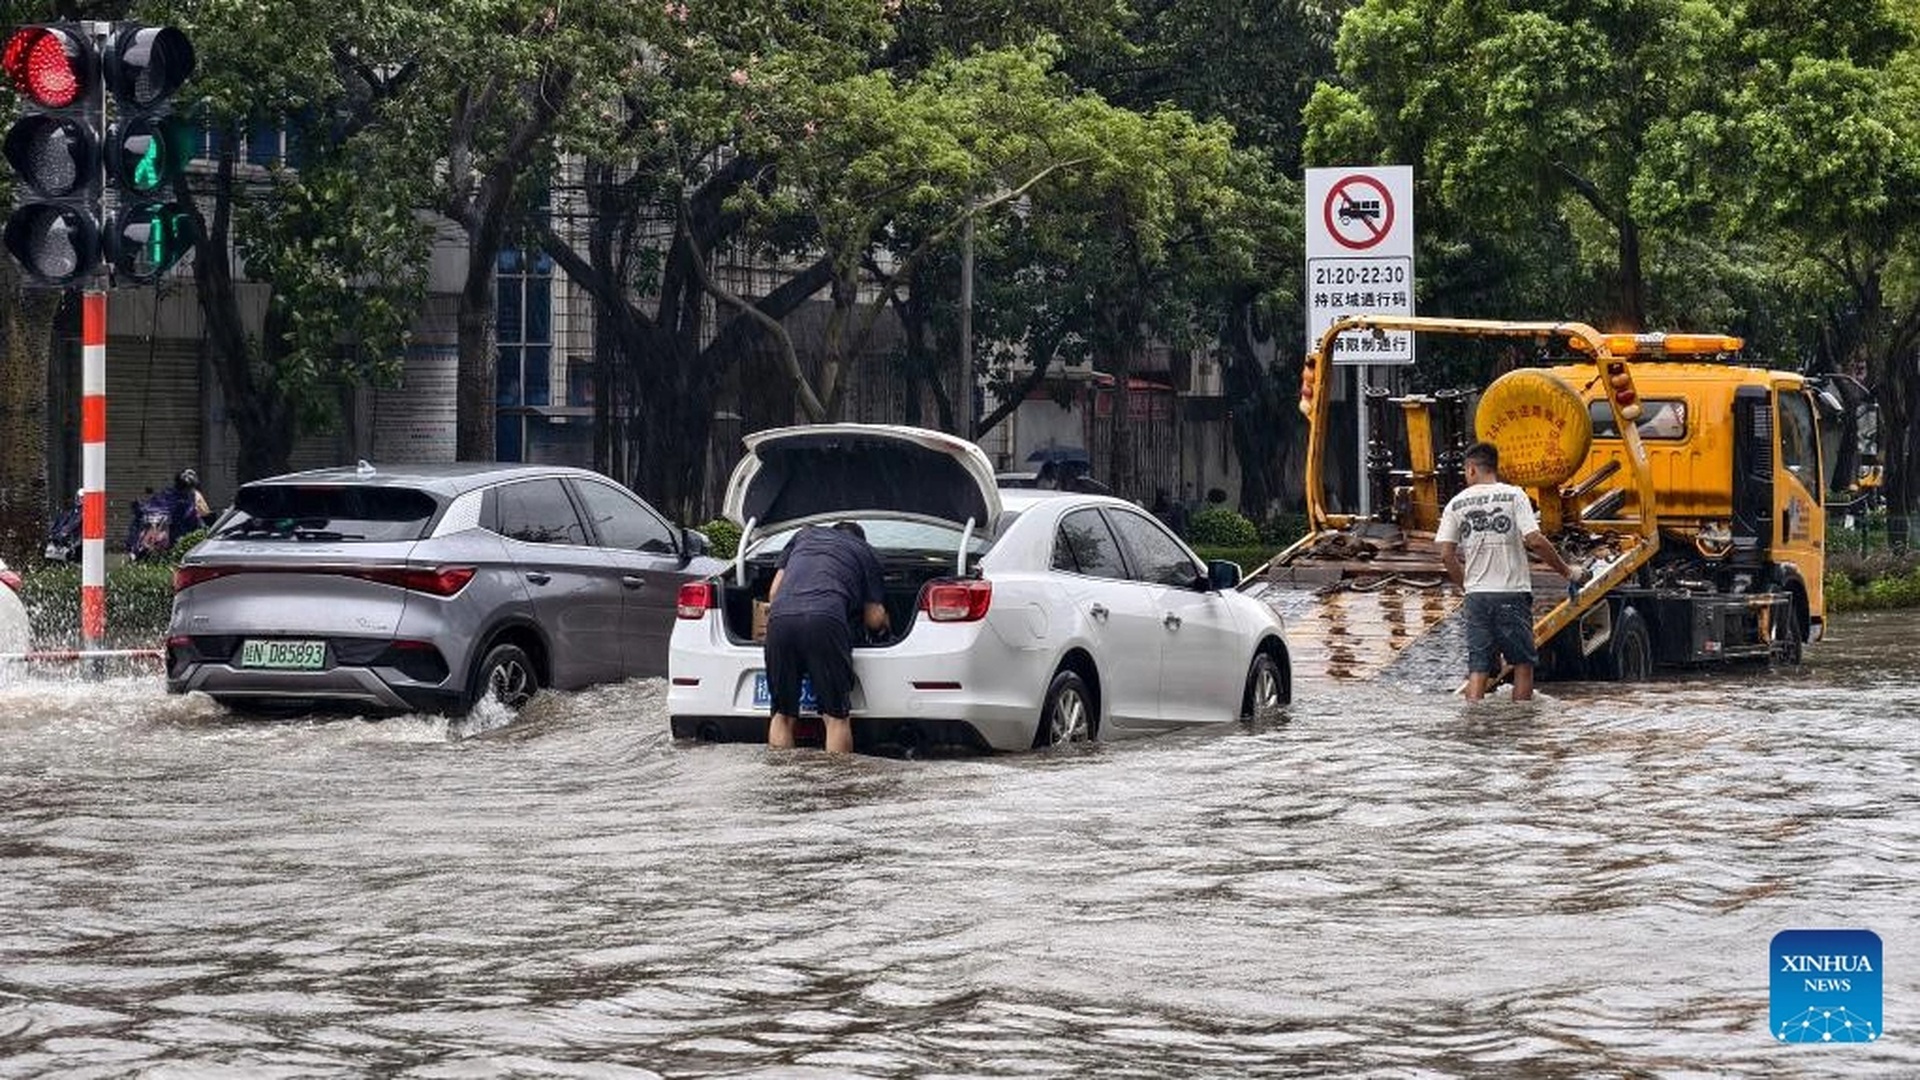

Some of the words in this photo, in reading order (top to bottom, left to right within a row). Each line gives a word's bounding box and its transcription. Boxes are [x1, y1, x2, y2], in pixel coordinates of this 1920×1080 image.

[1314, 291, 1407, 308] 持区域通行码
[268, 644, 323, 664] D85893
